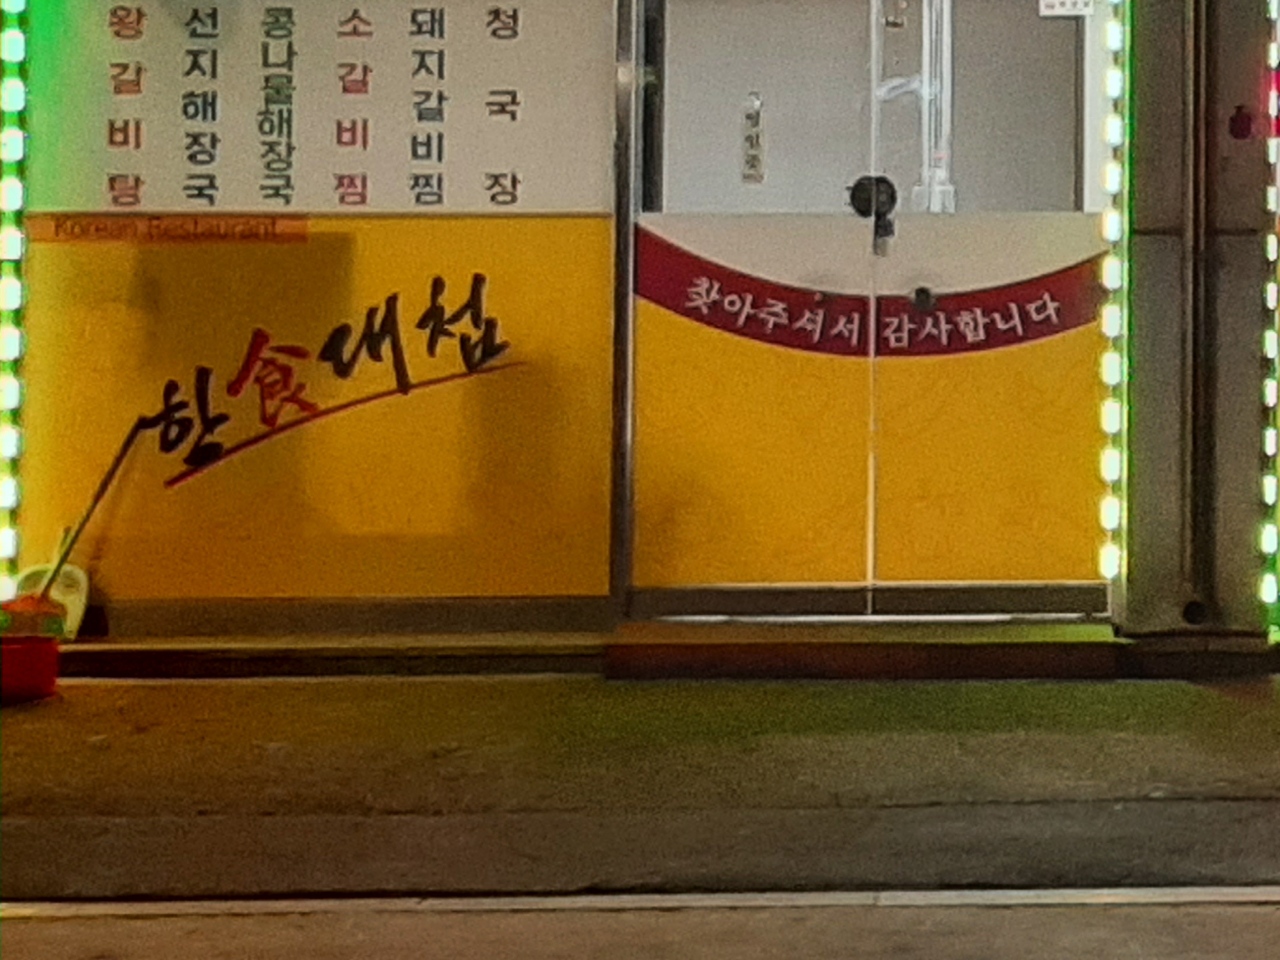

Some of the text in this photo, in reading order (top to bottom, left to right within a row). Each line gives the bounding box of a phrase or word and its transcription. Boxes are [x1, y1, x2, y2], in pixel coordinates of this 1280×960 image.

[107, 6, 147, 206] 왕갈비탕
[182, 6, 221, 206] 선지해장국
[257, 6, 298, 206] 콩나물해장국
[333, 7, 374, 206] 소갈비찜
[409, 6, 448, 206] 돼지갈비찜
[485, 6, 523, 206] 청국장
[54, 214, 278, 240] Korean Restaurant
[684, 276, 1061, 348] 찾아주셔서 감사합니다
